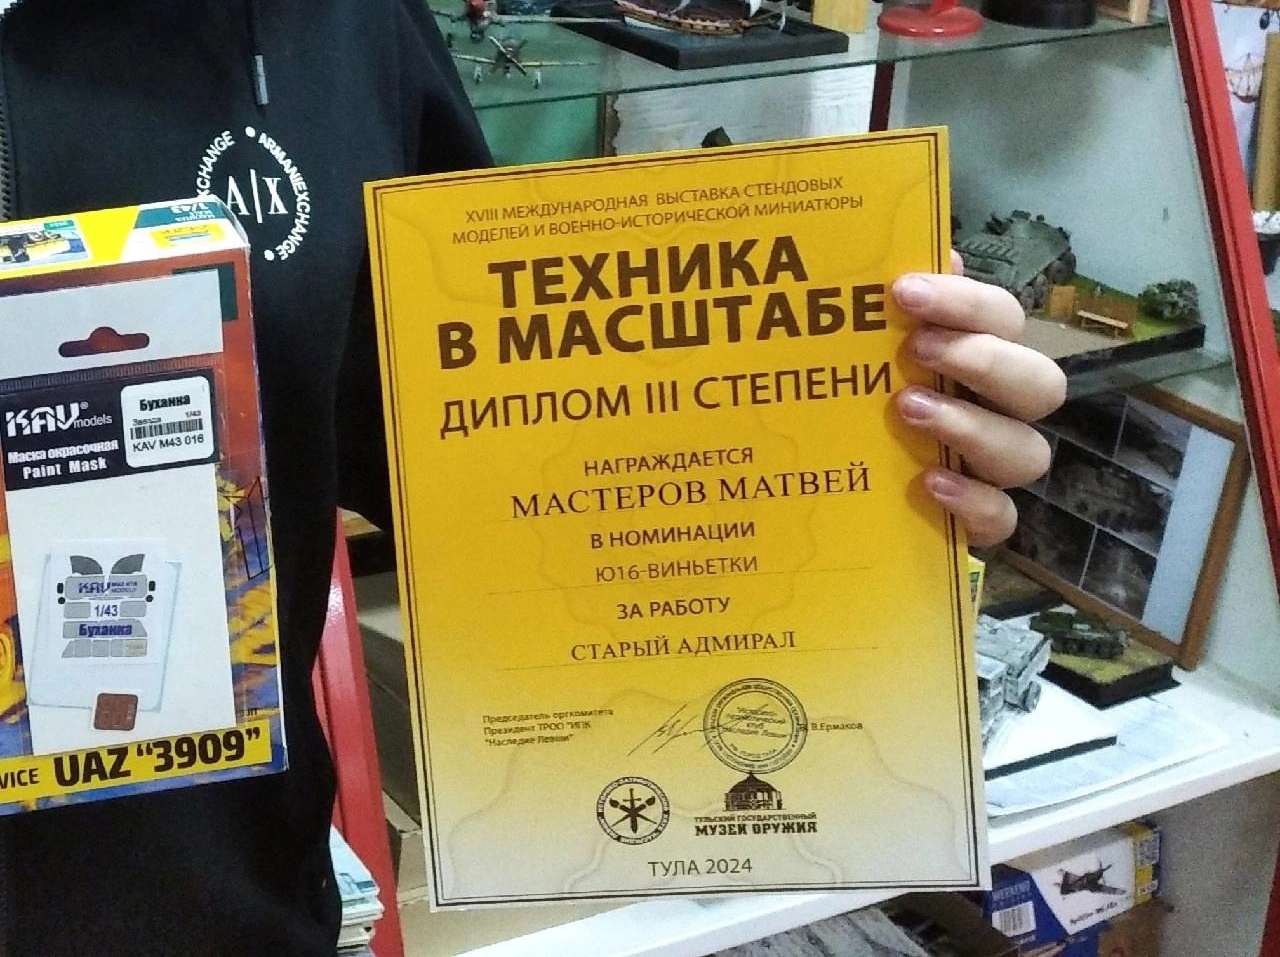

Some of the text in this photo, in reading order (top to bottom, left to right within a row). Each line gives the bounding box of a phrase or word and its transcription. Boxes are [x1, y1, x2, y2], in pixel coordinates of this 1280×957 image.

[465, 176, 844, 223] XVIII МЕЖДУНАРОДНАЯ ВЫСТАВКА СТЕНДОВЫХ
[452, 195, 863, 246] МОДЕЛЕЙ И ВОЕННО-ИСТОРИЧЕСКОЙ МИНИАТЮРЫ
[488, 235, 809, 309] ТЕХНИКА
[437, 284, 888, 370] В МАСШТАБЕ
[440, 361, 892, 440] ДИПЛОМ III СТЕПЕНИ
[73, 413, 113, 430] models
[7, 438, 120, 465] Маска окрасочная
[132, 433, 205, 453] KAV M43 016
[23, 457, 108, 480] Paint Mask
[583, 446, 754, 478] НАГРАЖДАЕТСЯ
[510, 460, 871, 519] МАСТЕРОВ МАТВЕЙ
[590, 522, 756, 549] В НОМИНАЦИИ
[595, 555, 758, 583] Ю16-ВИНЬЕТКИ
[94, 604, 118, 618] 1/43
[616, 596, 731, 620] ЗА РАБОТУ
[570, 630, 797, 662] СТАРЫЙ АДМИРАЛ
[482, 709, 614, 725] Председатель оргкомитета
[483, 725, 535, 737] Президент
[537, 722, 565, 732] ТРОО
[53, 746, 132, 788] UAZ
[737, 812, 817, 823] ГОСУДАРСТВЕННЫЙ
[751, 821, 818, 835] ОРУЖИЯ
[647, 857, 753, 877] ТУЛА 2024
